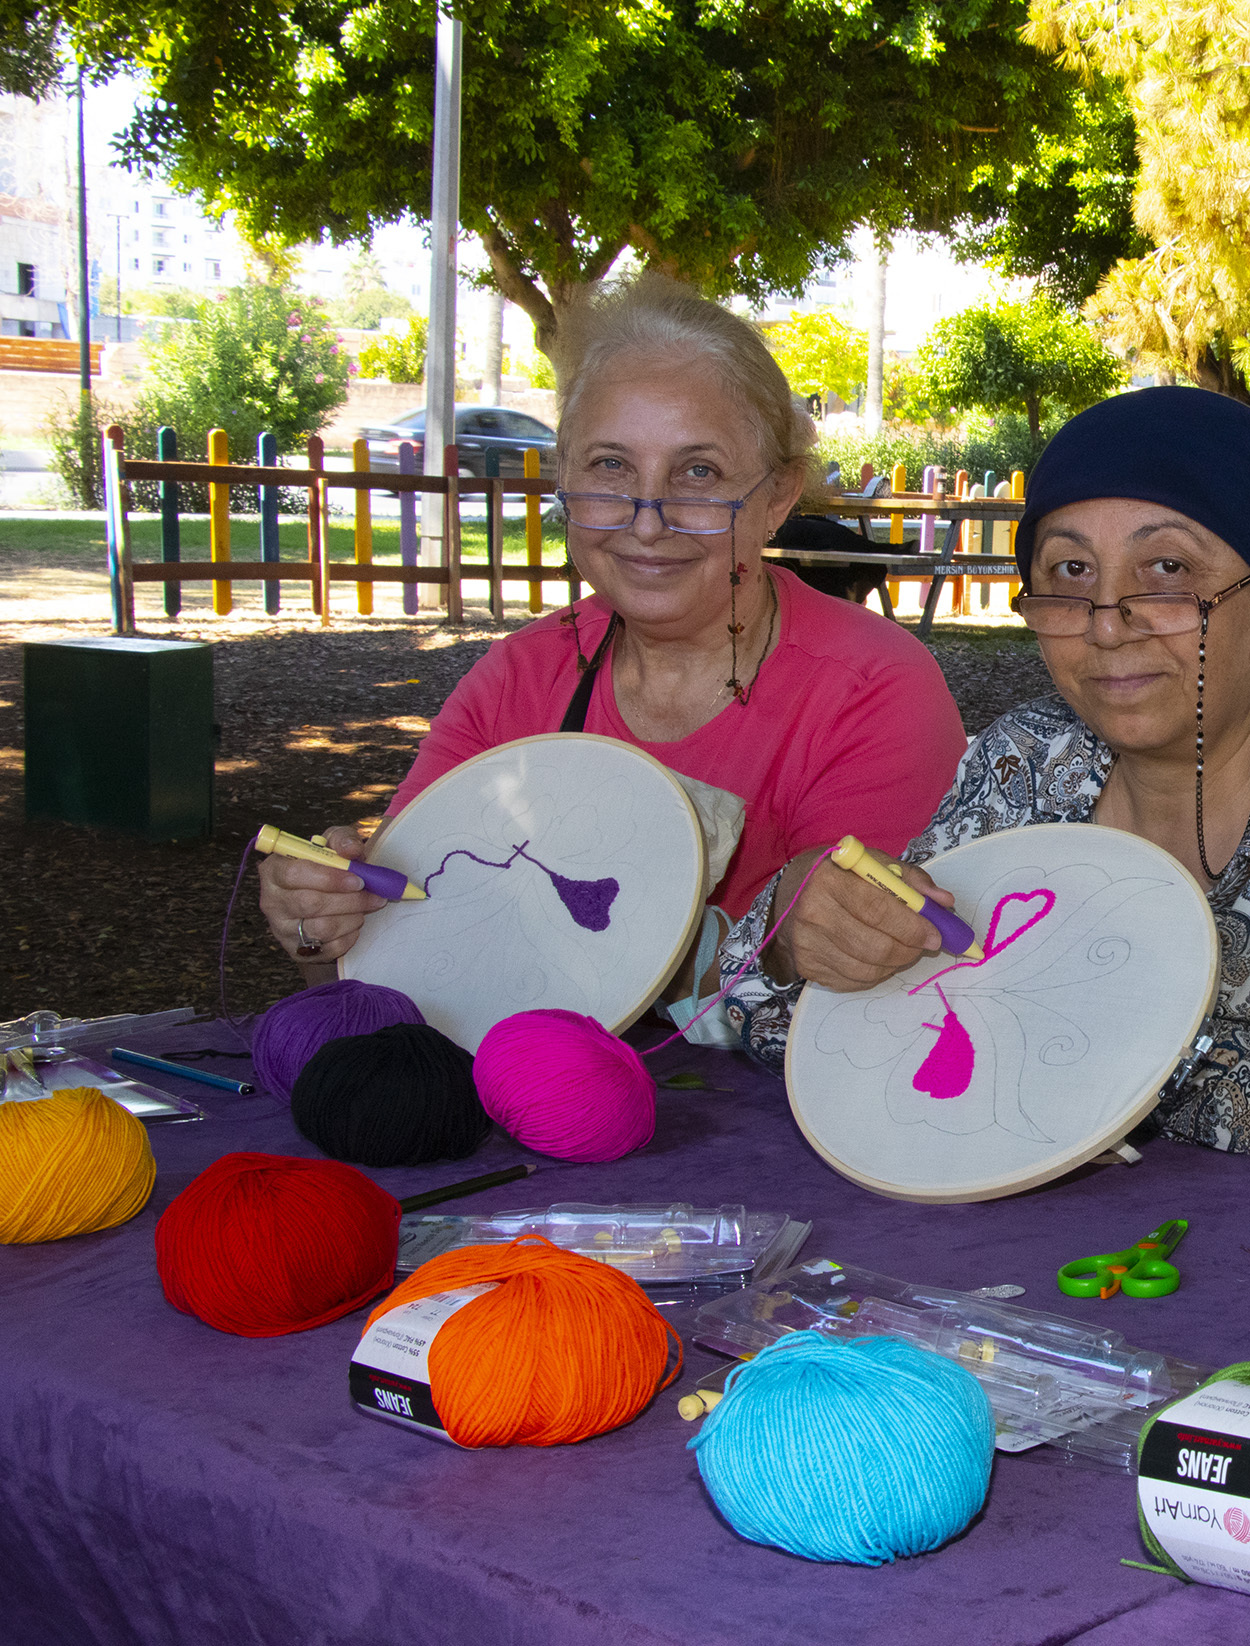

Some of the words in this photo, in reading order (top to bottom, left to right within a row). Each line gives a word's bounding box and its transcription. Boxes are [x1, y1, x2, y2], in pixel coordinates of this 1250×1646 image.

[373, 1387, 414, 1417] JEANS
[1225, 1406, 1250, 1418] Cotton
[1176, 1447, 1233, 1485] JEANS
[1154, 1495, 1223, 1531] YarnArt
